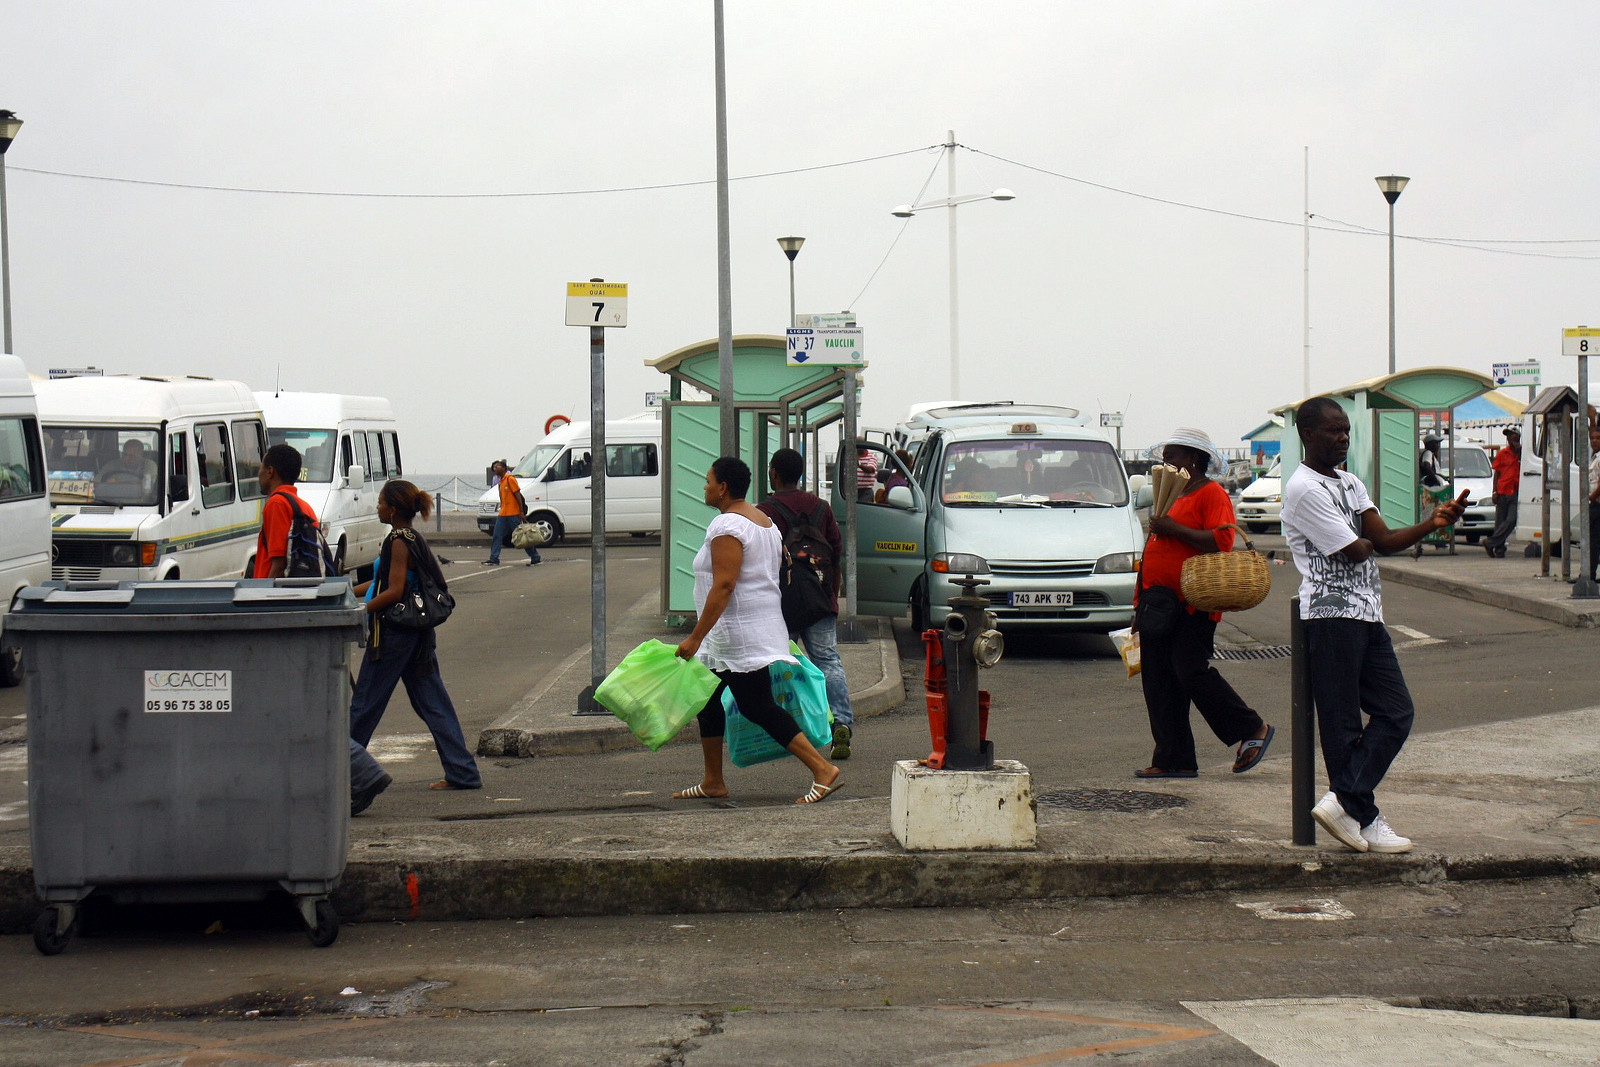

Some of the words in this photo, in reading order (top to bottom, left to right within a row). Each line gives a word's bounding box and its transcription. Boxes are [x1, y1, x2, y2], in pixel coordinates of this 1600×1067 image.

[592, 302, 604, 322] 7
[804, 336, 814, 350] 37
[825, 338, 855, 348] VAUCLIN
[1580, 339, 1588, 352] 8
[1015, 594, 1030, 604] 743
[1034, 594, 1052, 604] APK
[1056, 594, 1071, 604] 972
[168, 672, 227, 687] CACEM
[147, 700, 161, 711] 05
[164, 700, 178, 711] 96
[182, 700, 195, 711] 75
[199, 700, 213, 711] 38
[216, 700, 230, 711] 05
